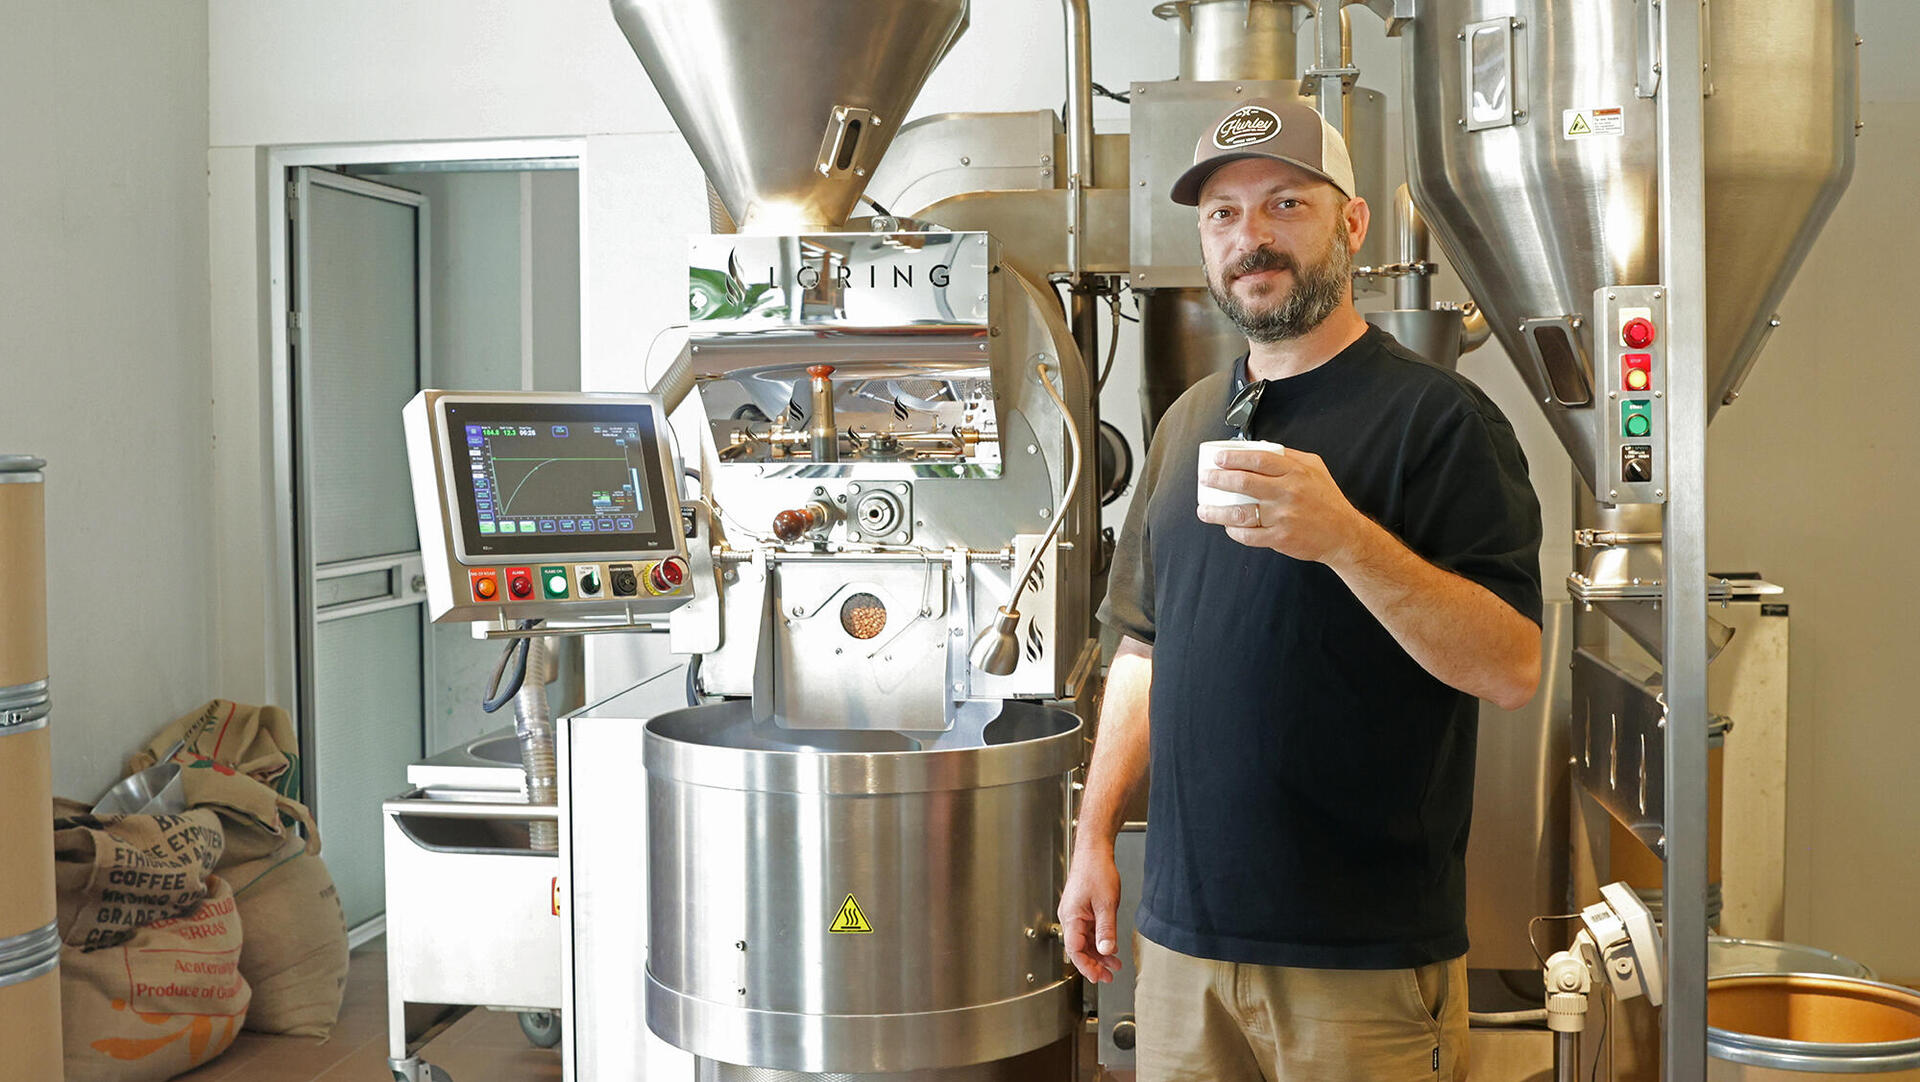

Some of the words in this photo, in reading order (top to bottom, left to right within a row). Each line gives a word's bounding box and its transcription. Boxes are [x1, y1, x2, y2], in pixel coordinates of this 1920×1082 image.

[1220, 117, 1273, 138] Hurley
[769, 264, 950, 290] LORING
[109, 869, 187, 891] COFFEE
[136, 982, 199, 999] Produce
[201, 984, 215, 999] of
